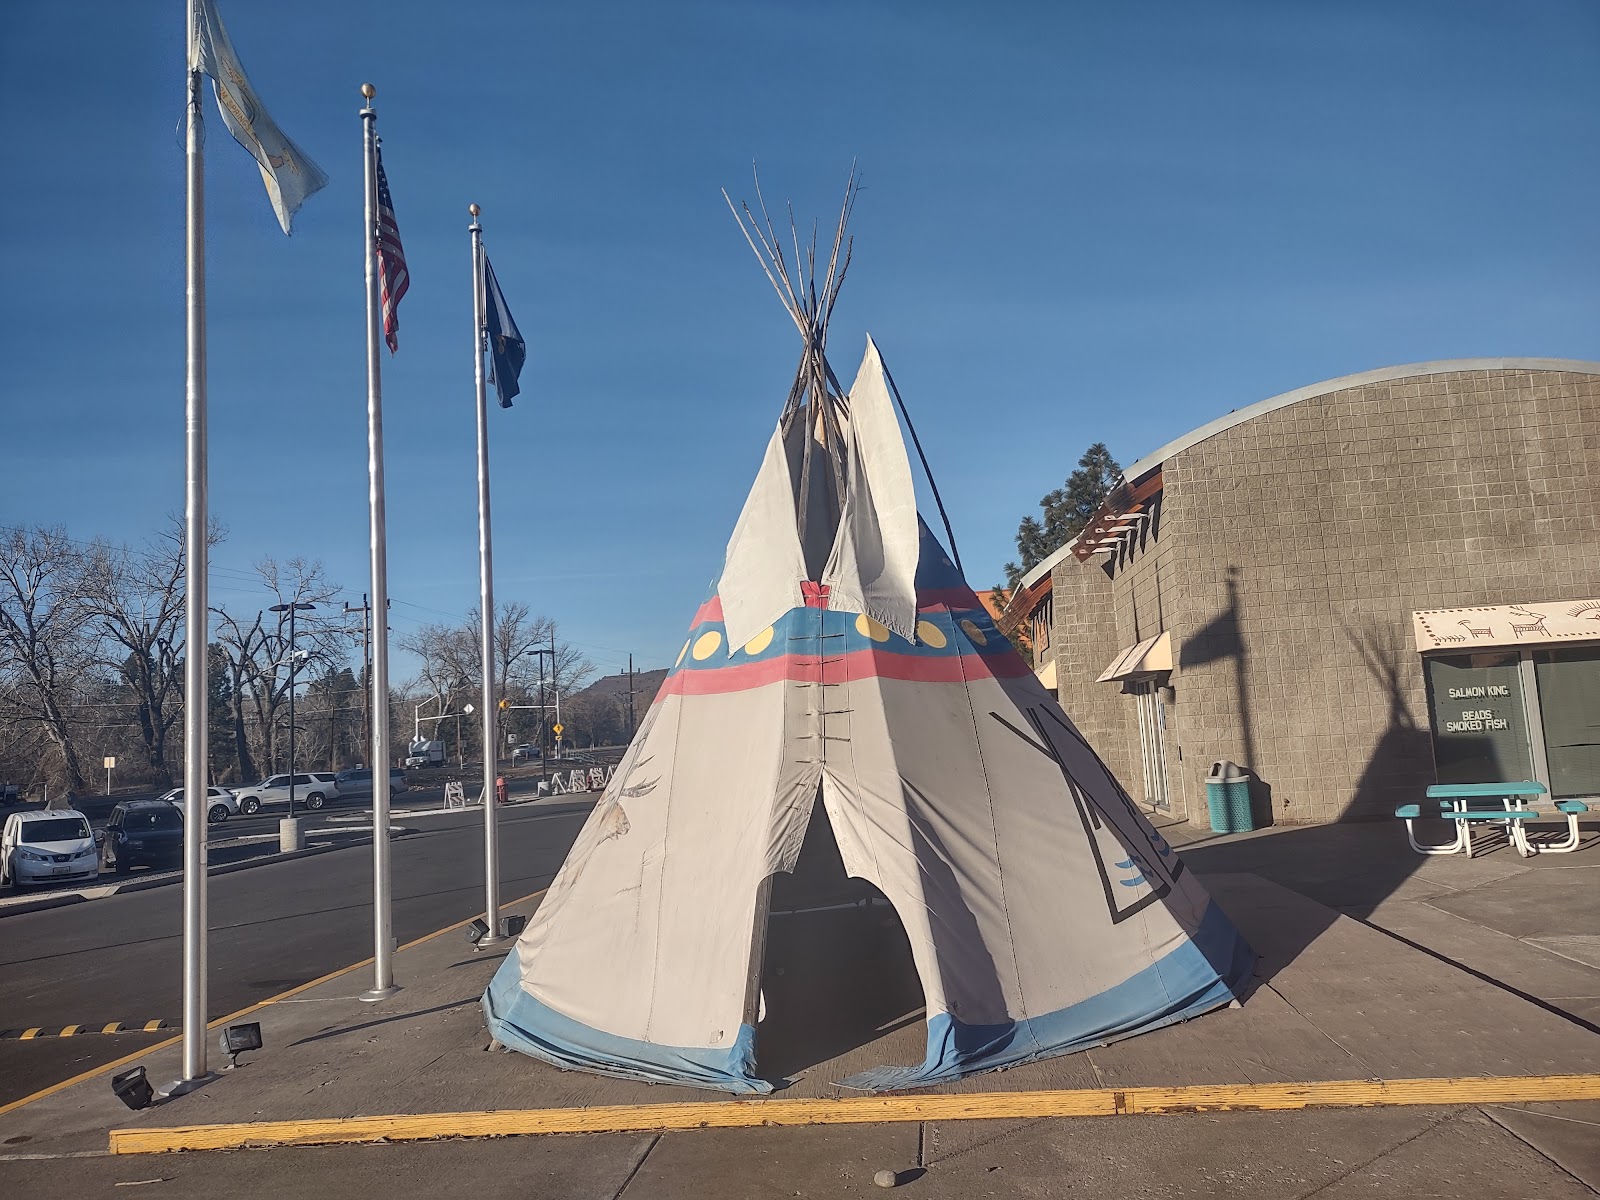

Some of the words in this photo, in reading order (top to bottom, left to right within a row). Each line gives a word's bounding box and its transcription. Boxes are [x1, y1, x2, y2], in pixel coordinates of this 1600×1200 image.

[227, 100, 252, 131] SPRINGS
[1448, 686, 1486, 698] SALMON
[1487, 685, 1508, 696] KING
[1462, 709, 1492, 721] BEADS
[1446, 720, 1483, 732] SMOKED
[1485, 718, 1507, 730] FISH
